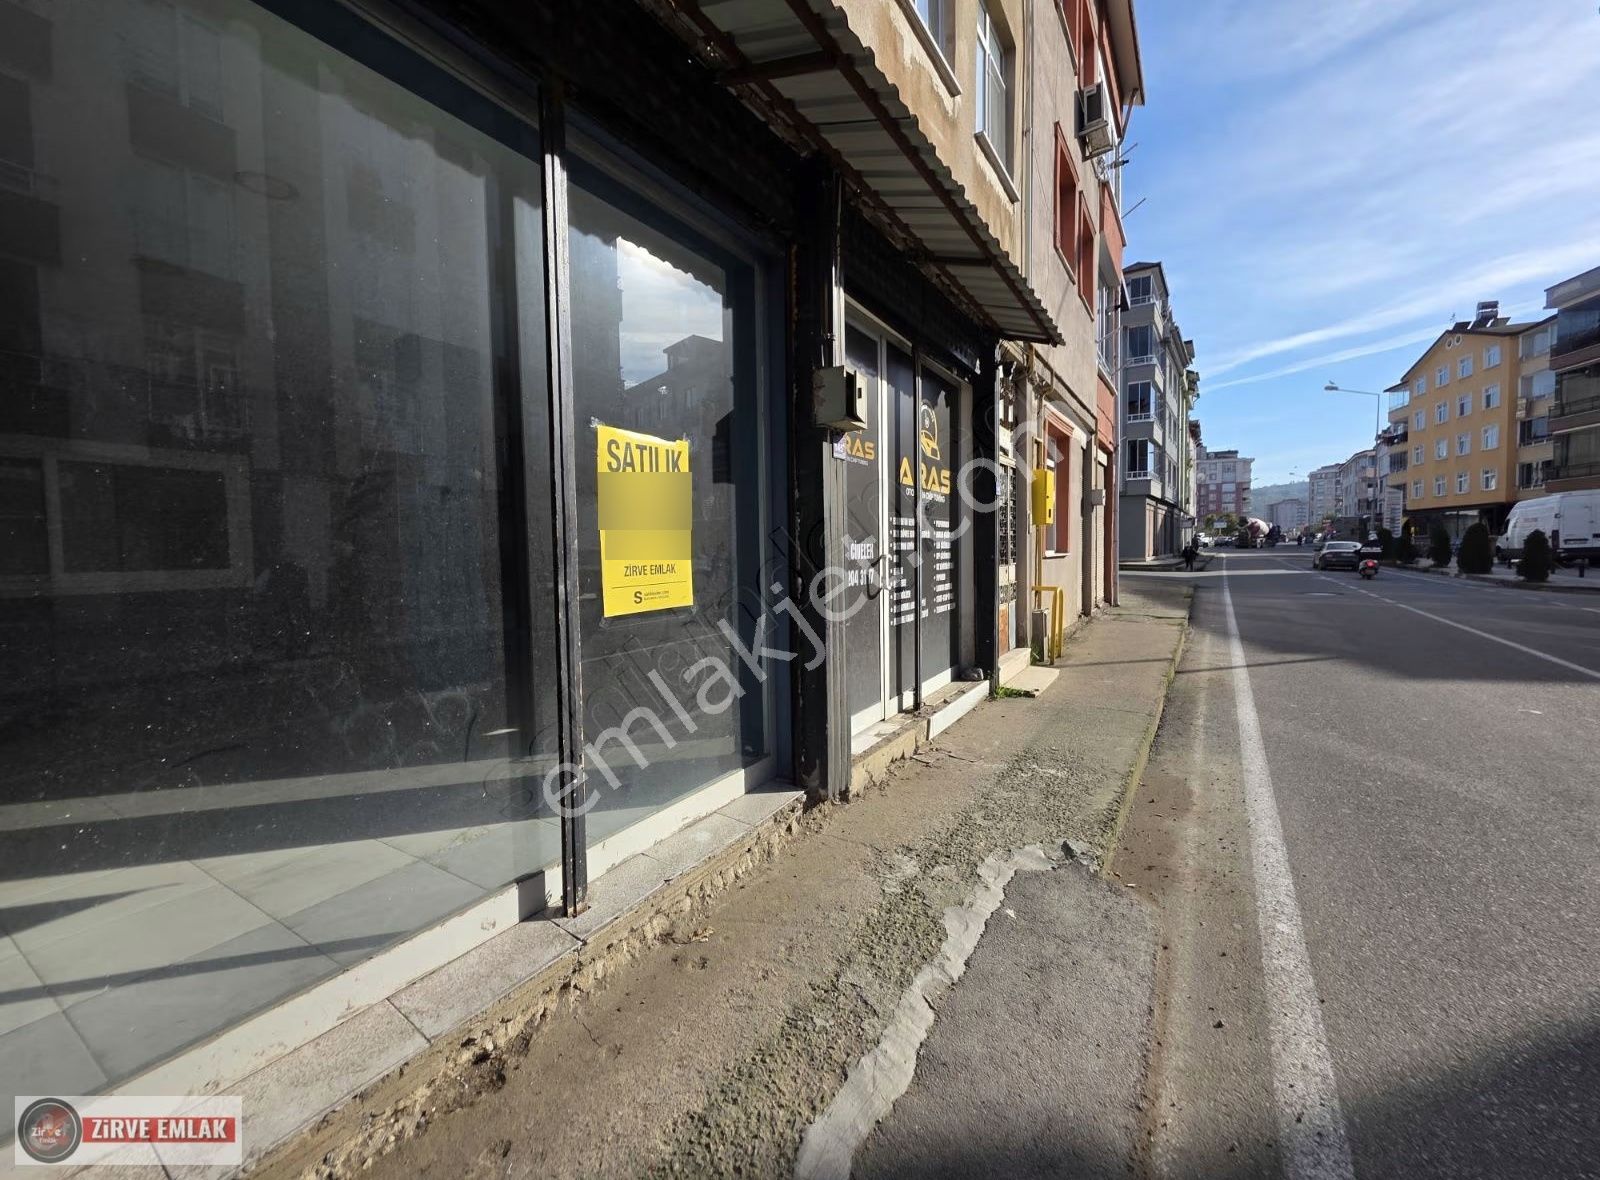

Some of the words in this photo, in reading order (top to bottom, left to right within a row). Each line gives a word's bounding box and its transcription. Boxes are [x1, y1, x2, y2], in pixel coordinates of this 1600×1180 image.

[845, 436, 875, 460] RAS
[900, 456, 951, 494] ARAS
[624, 563, 648, 577] ZİRVE
[650, 563, 676, 576] EMLAK
